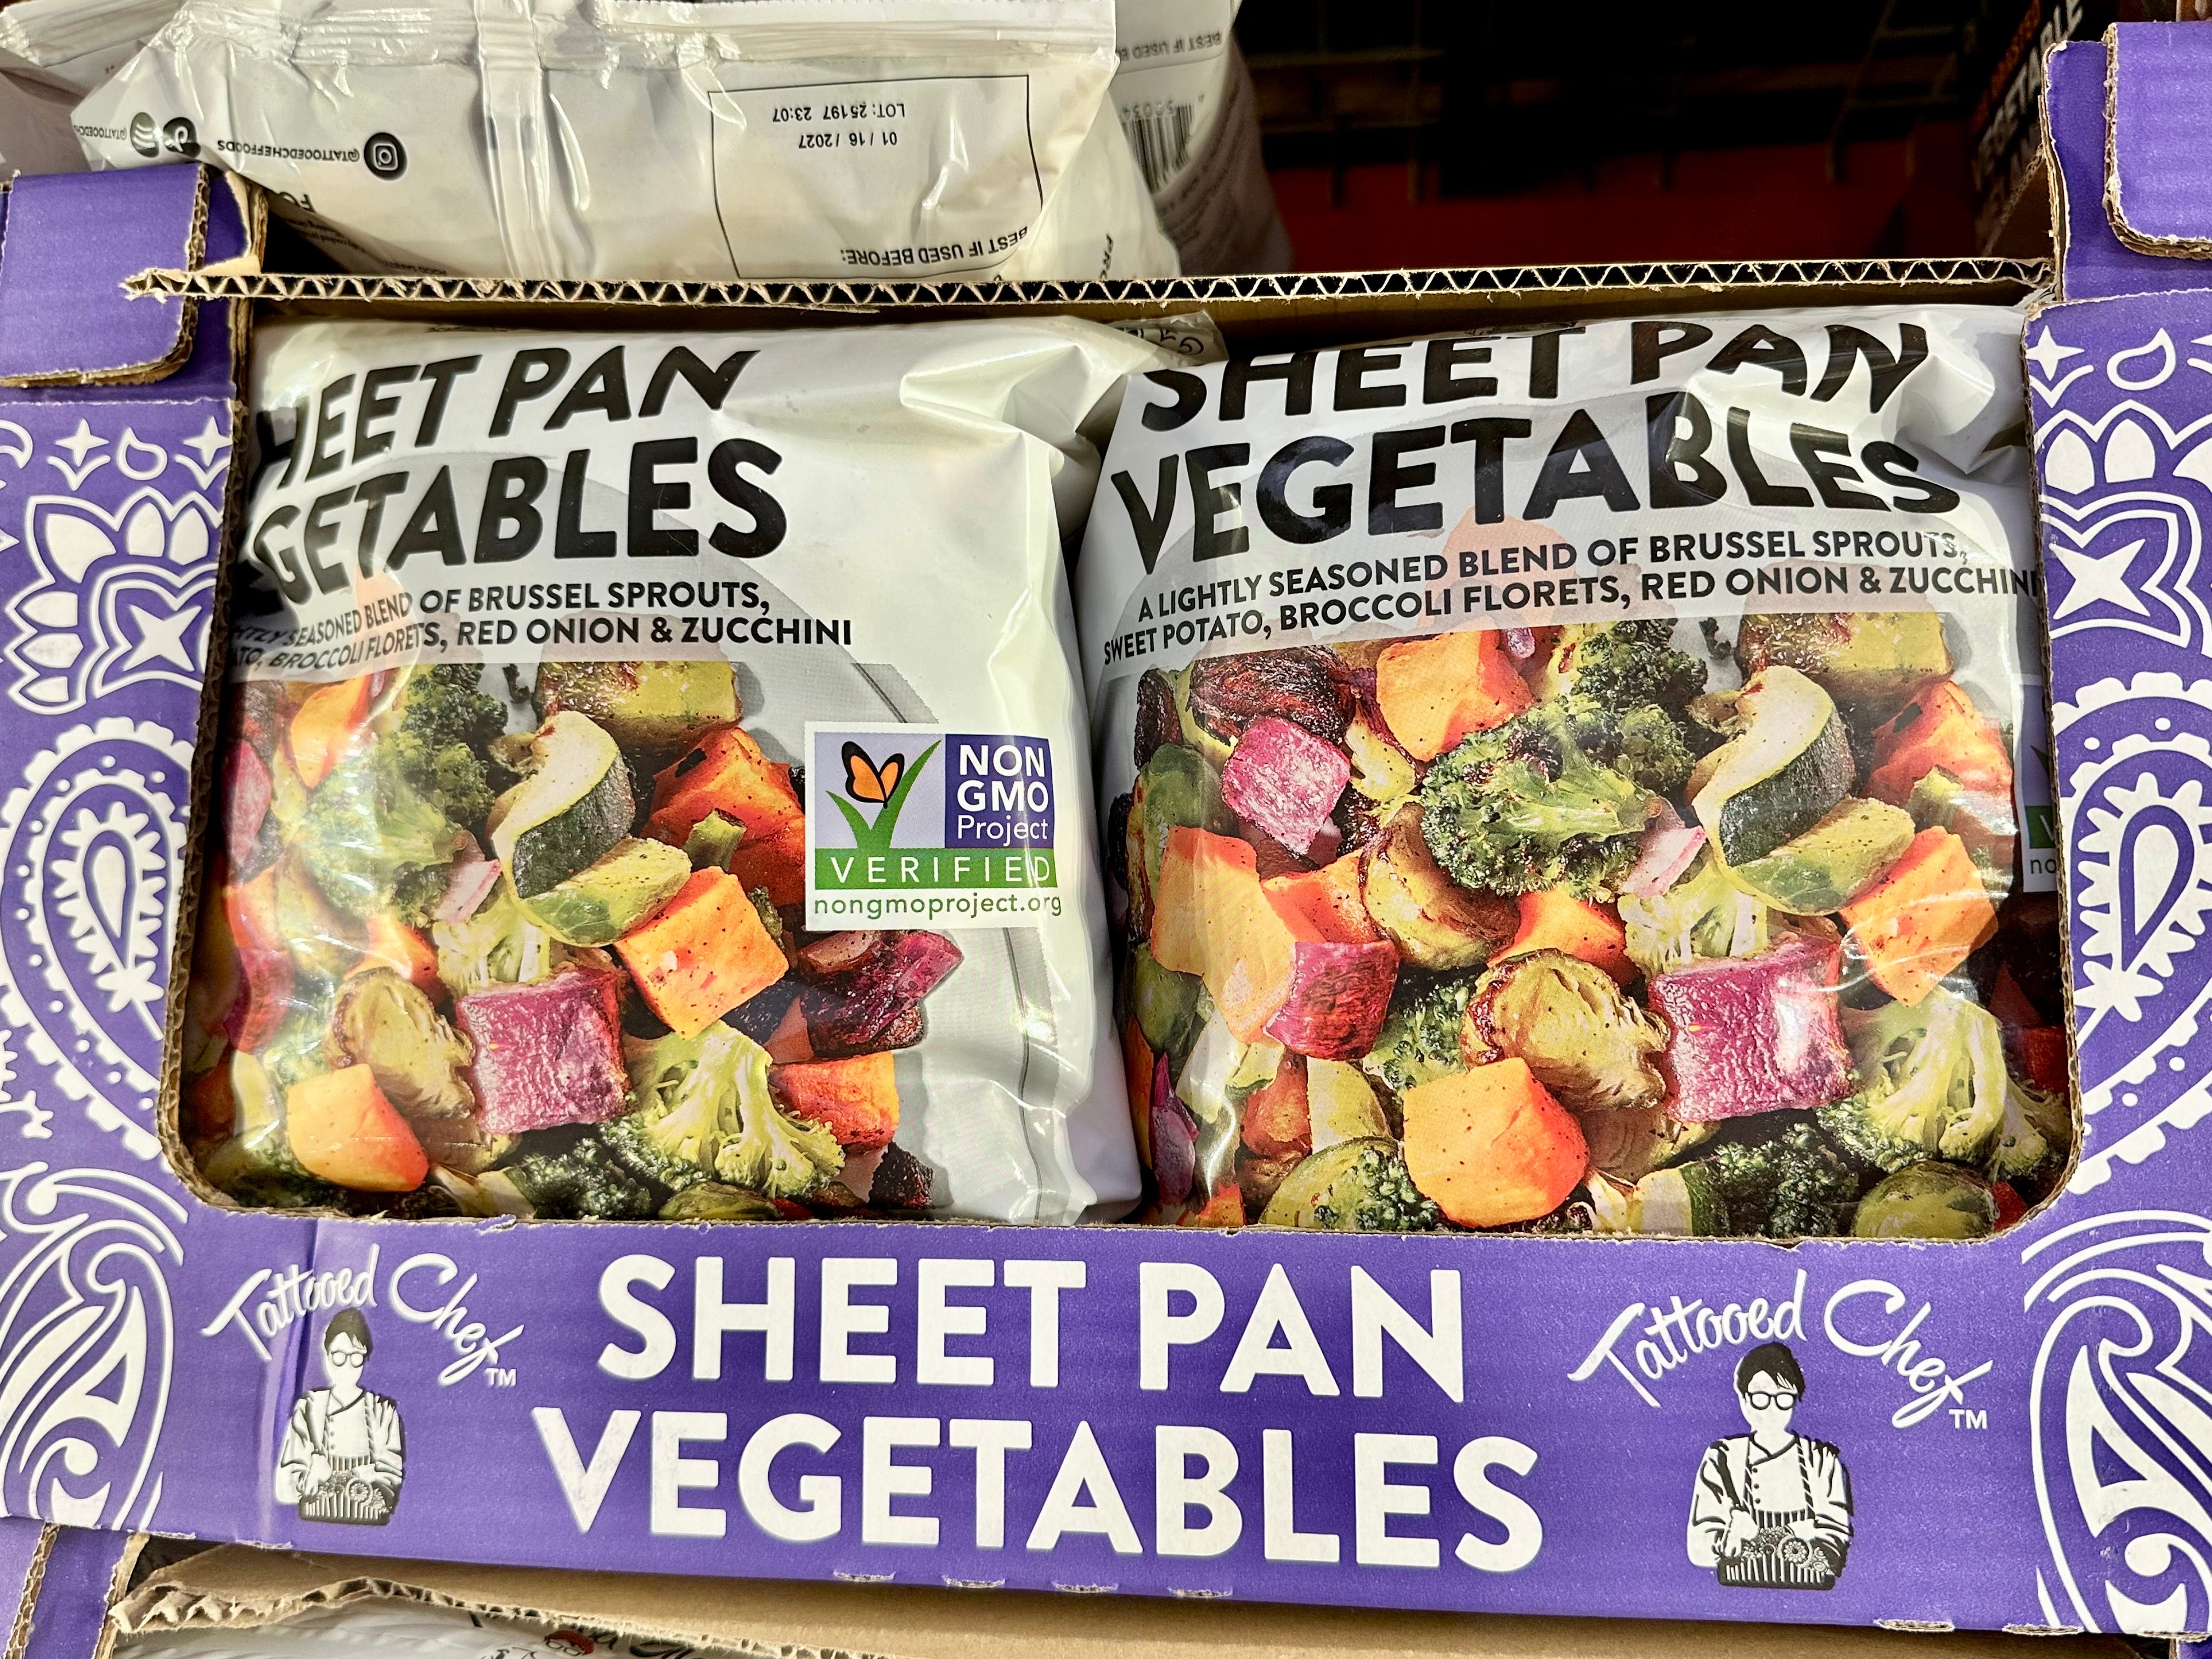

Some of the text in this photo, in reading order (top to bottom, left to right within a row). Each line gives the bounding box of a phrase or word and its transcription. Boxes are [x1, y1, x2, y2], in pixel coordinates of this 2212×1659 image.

[772, 103, 905, 122] LOT: 25197 23:07
[217, 139, 360, 162] @TATTOOEDCHEFFOODS
[840, 226, 1028, 266] BEST IF USED BEFORE:
[488, 346, 761, 438] PAN
[1141, 321, 1929, 432] SHEET PAN
[1110, 391, 1961, 577] VEGETABLES
[233, 436, 788, 606] GETABLES
[364, 591, 413, 629] BLEND
[419, 589, 462, 613] OF
[468, 584, 600, 611] BRUSSEL
[607, 582, 770, 616] SPROUTS,
[1138, 530, 1971, 623] A LIGHTLY SEASONED BLEND OF BRUSSEL SPROUTS,
[269, 639, 363, 670] BROCCOLI
[364, 620, 449, 661] FLORETS,
[456, 620, 518, 646] RED
[524, 616, 641, 644] ONION
[650, 620, 674, 643] &
[682, 616, 855, 645] ZUCCHINI
[1104, 565, 2039, 667] SWEET POTATO, BROCCOLI FLORETS, RED ONION & ZUCCHINI
[956, 779, 1050, 813] GMO
[958, 744, 1046, 778] NON
[956, 814, 1049, 847] Project
[814, 891, 1063, 921] nongmoproject.org
[830, 856, 1051, 884] VERIFIED
[201, 1242, 526, 1387] Tattooed Chef TM
[595, 1253, 1464, 1403] SHEET PAN
[1566, 1267, 1994, 1430] Tattooed Chef TM
[531, 1404, 1545, 1573] VEGETABLES
